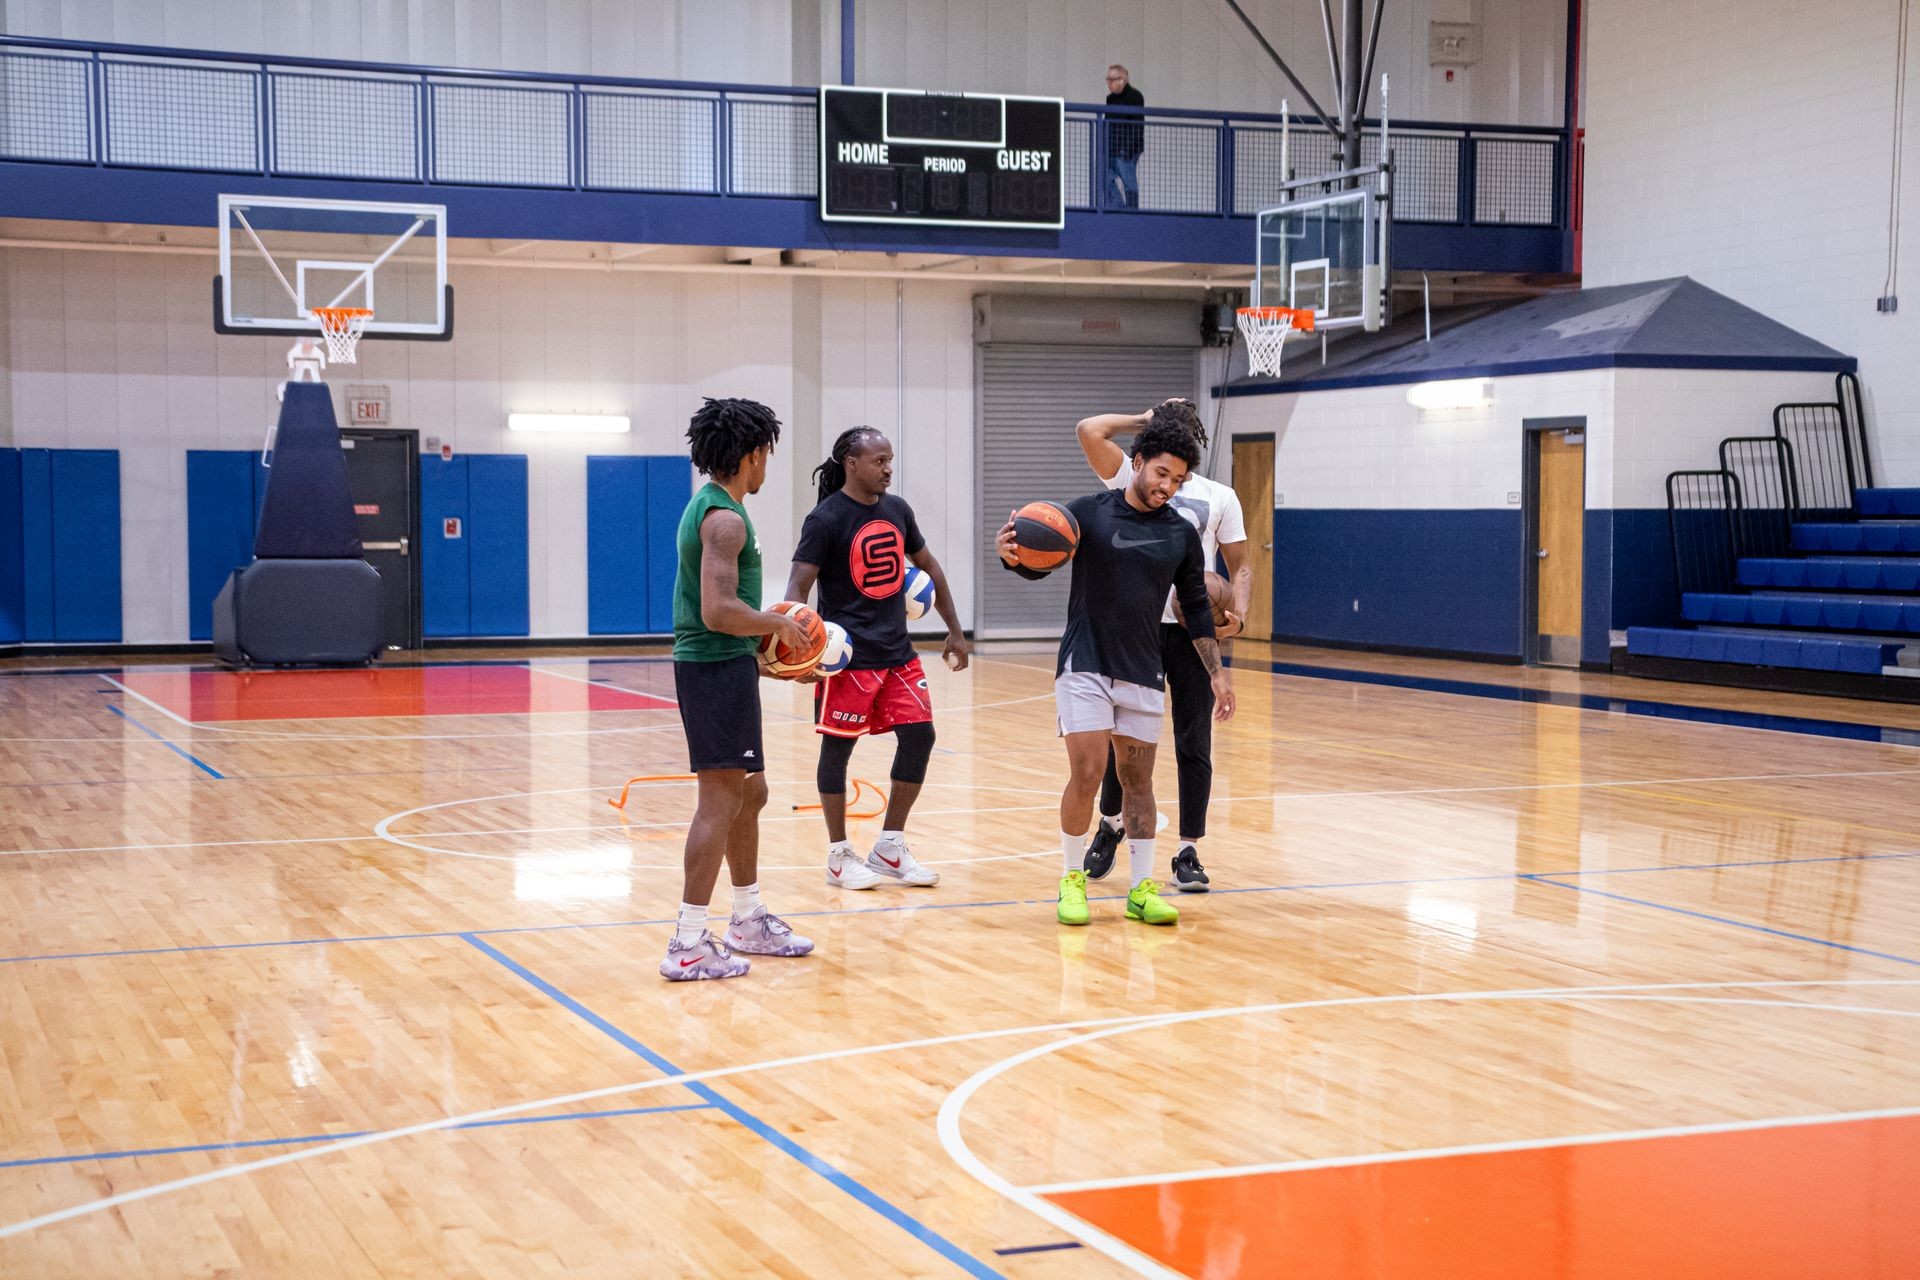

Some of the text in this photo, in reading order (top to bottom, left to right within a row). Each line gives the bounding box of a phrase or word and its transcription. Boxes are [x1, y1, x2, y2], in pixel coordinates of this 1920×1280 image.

[838, 142, 889, 164] HOME
[997, 150, 1051, 171] GUEST
[924, 157, 966, 173] PERIOD
[358, 402, 380, 418] EXIT
